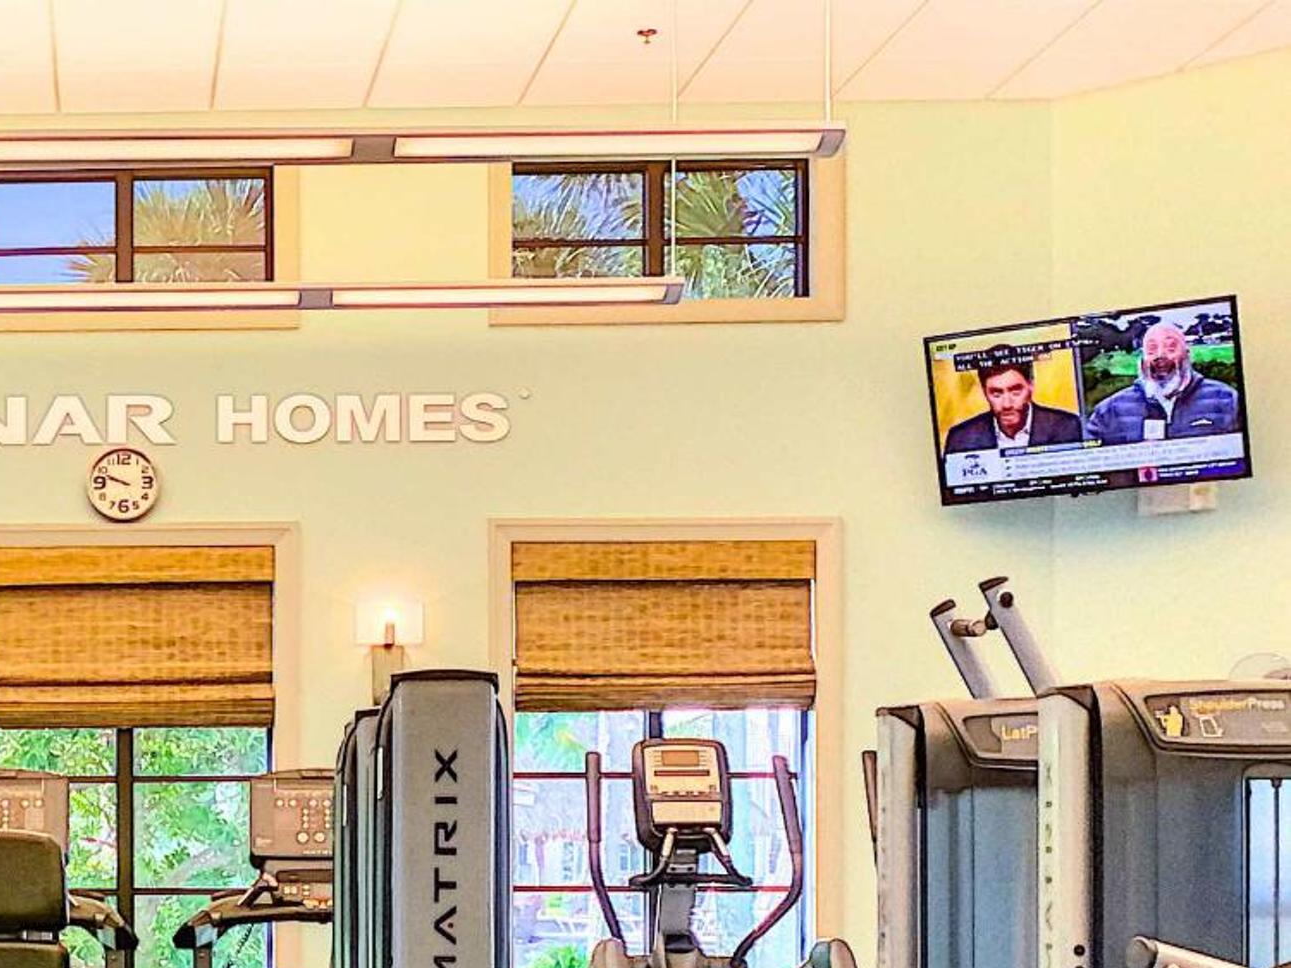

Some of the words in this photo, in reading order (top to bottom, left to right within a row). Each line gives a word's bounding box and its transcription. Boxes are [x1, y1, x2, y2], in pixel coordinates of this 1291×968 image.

[214, 391, 512, 445] HOMES
[116, 453, 131, 466] 12
[962, 467, 987, 477] PGA
[92, 475, 106, 490] 9
[141, 475, 153, 490] 3
[110, 500, 116, 510] 7
[117, 498, 130, 514] 6
[131, 500, 139, 510] 5
